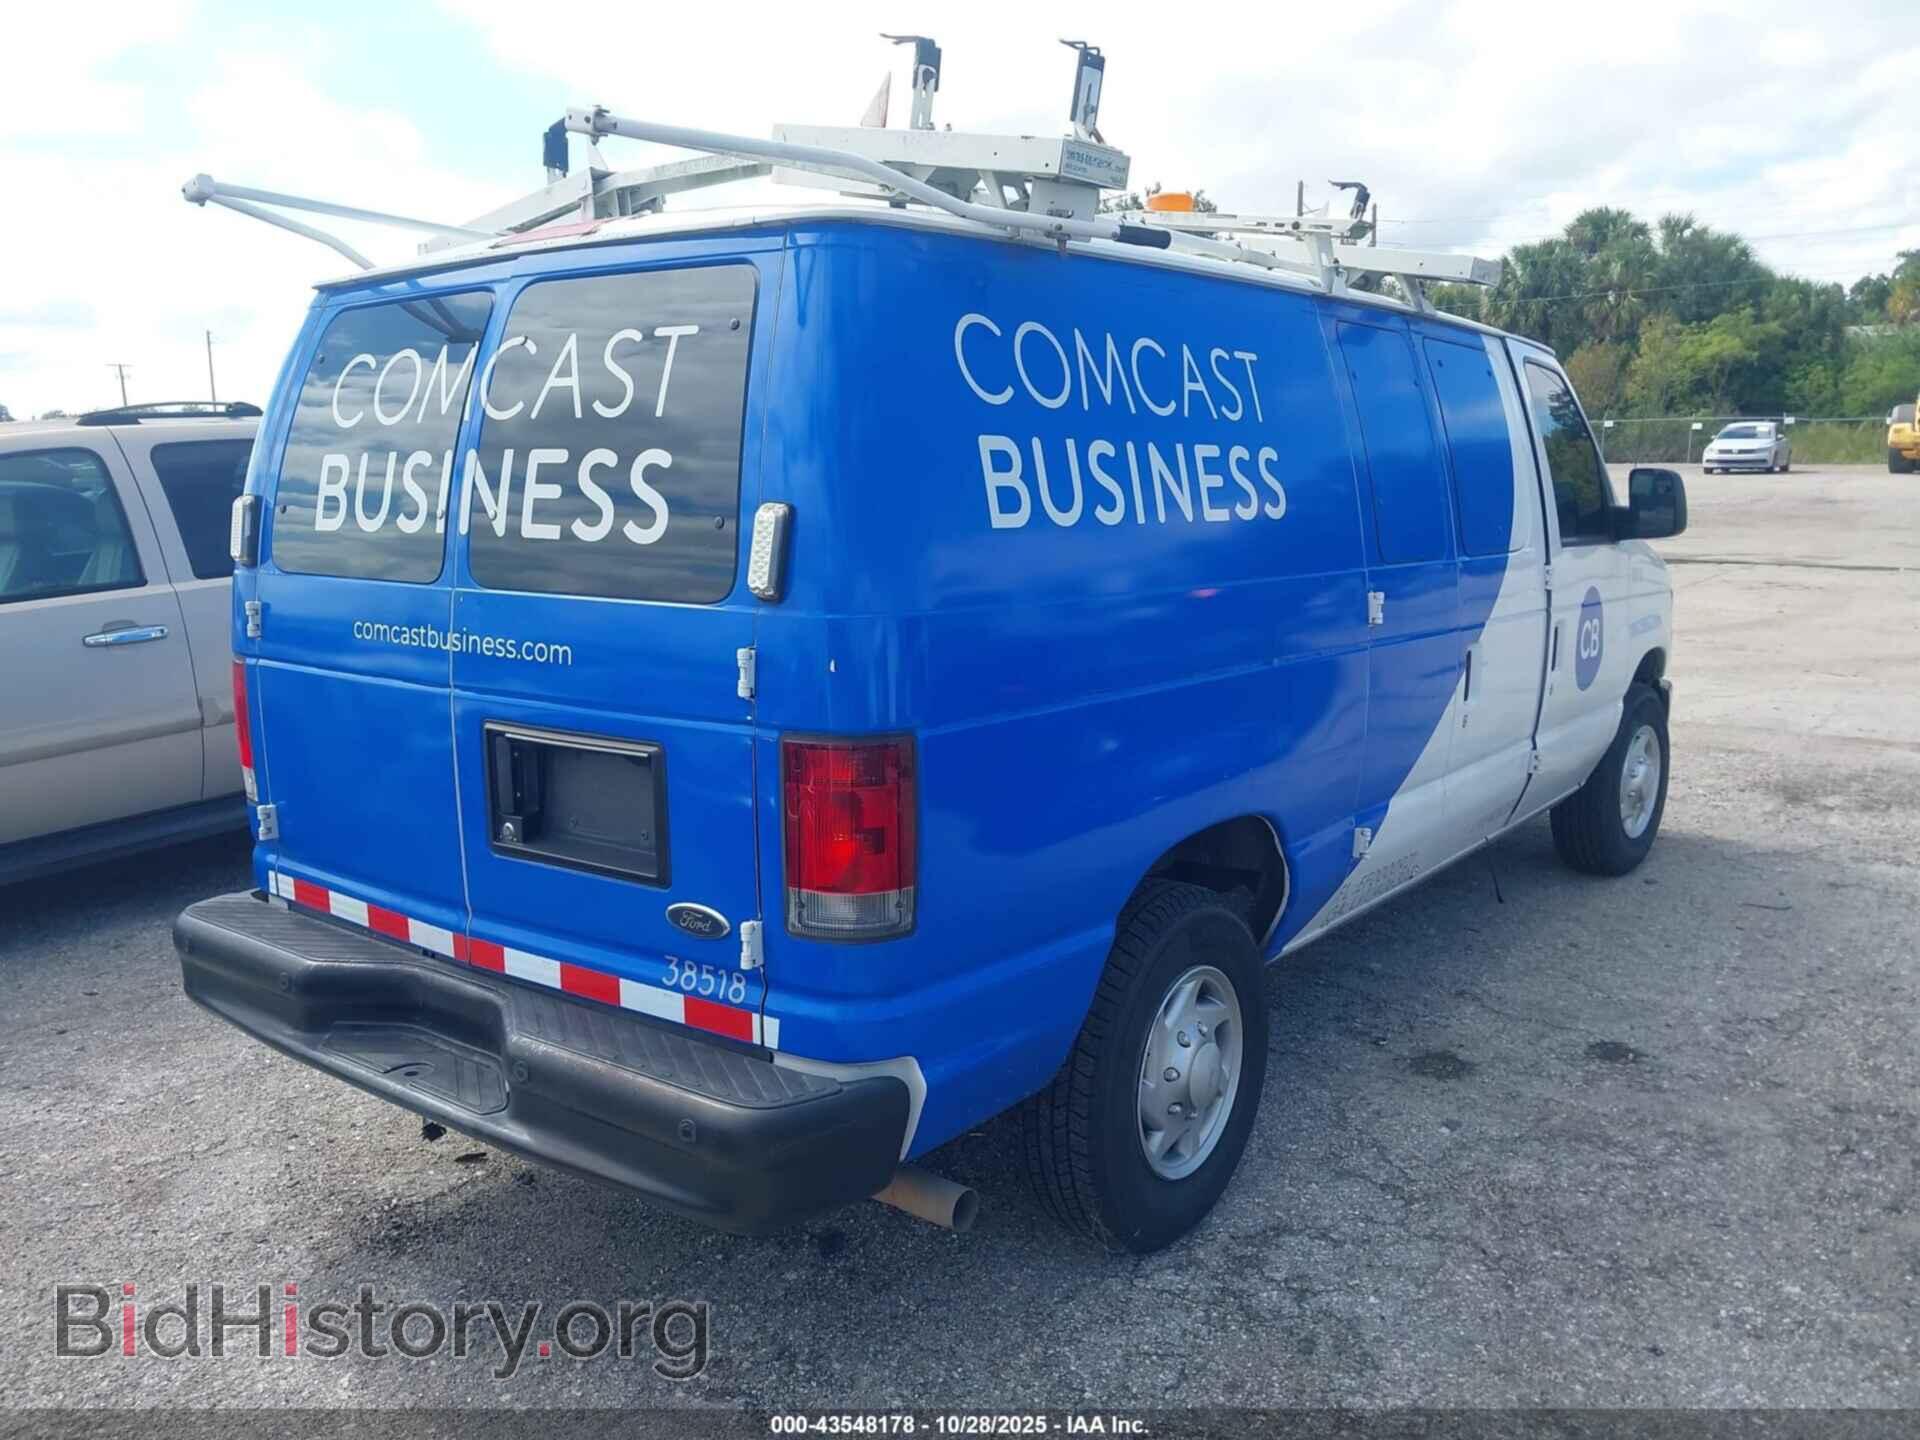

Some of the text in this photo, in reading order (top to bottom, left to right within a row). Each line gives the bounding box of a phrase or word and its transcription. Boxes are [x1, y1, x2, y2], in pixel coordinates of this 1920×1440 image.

[331, 324, 699, 428] COMCAST
[954, 313, 1263, 423] COMCAST
[314, 447, 673, 545] BUSINESS
[977, 435, 1287, 529] BUSINESS
[353, 620, 572, 665] comcastbusiness.com
[1581, 618, 1600, 659] CB
[679, 909, 713, 932] Ford
[662, 954, 746, 1004] 38518
